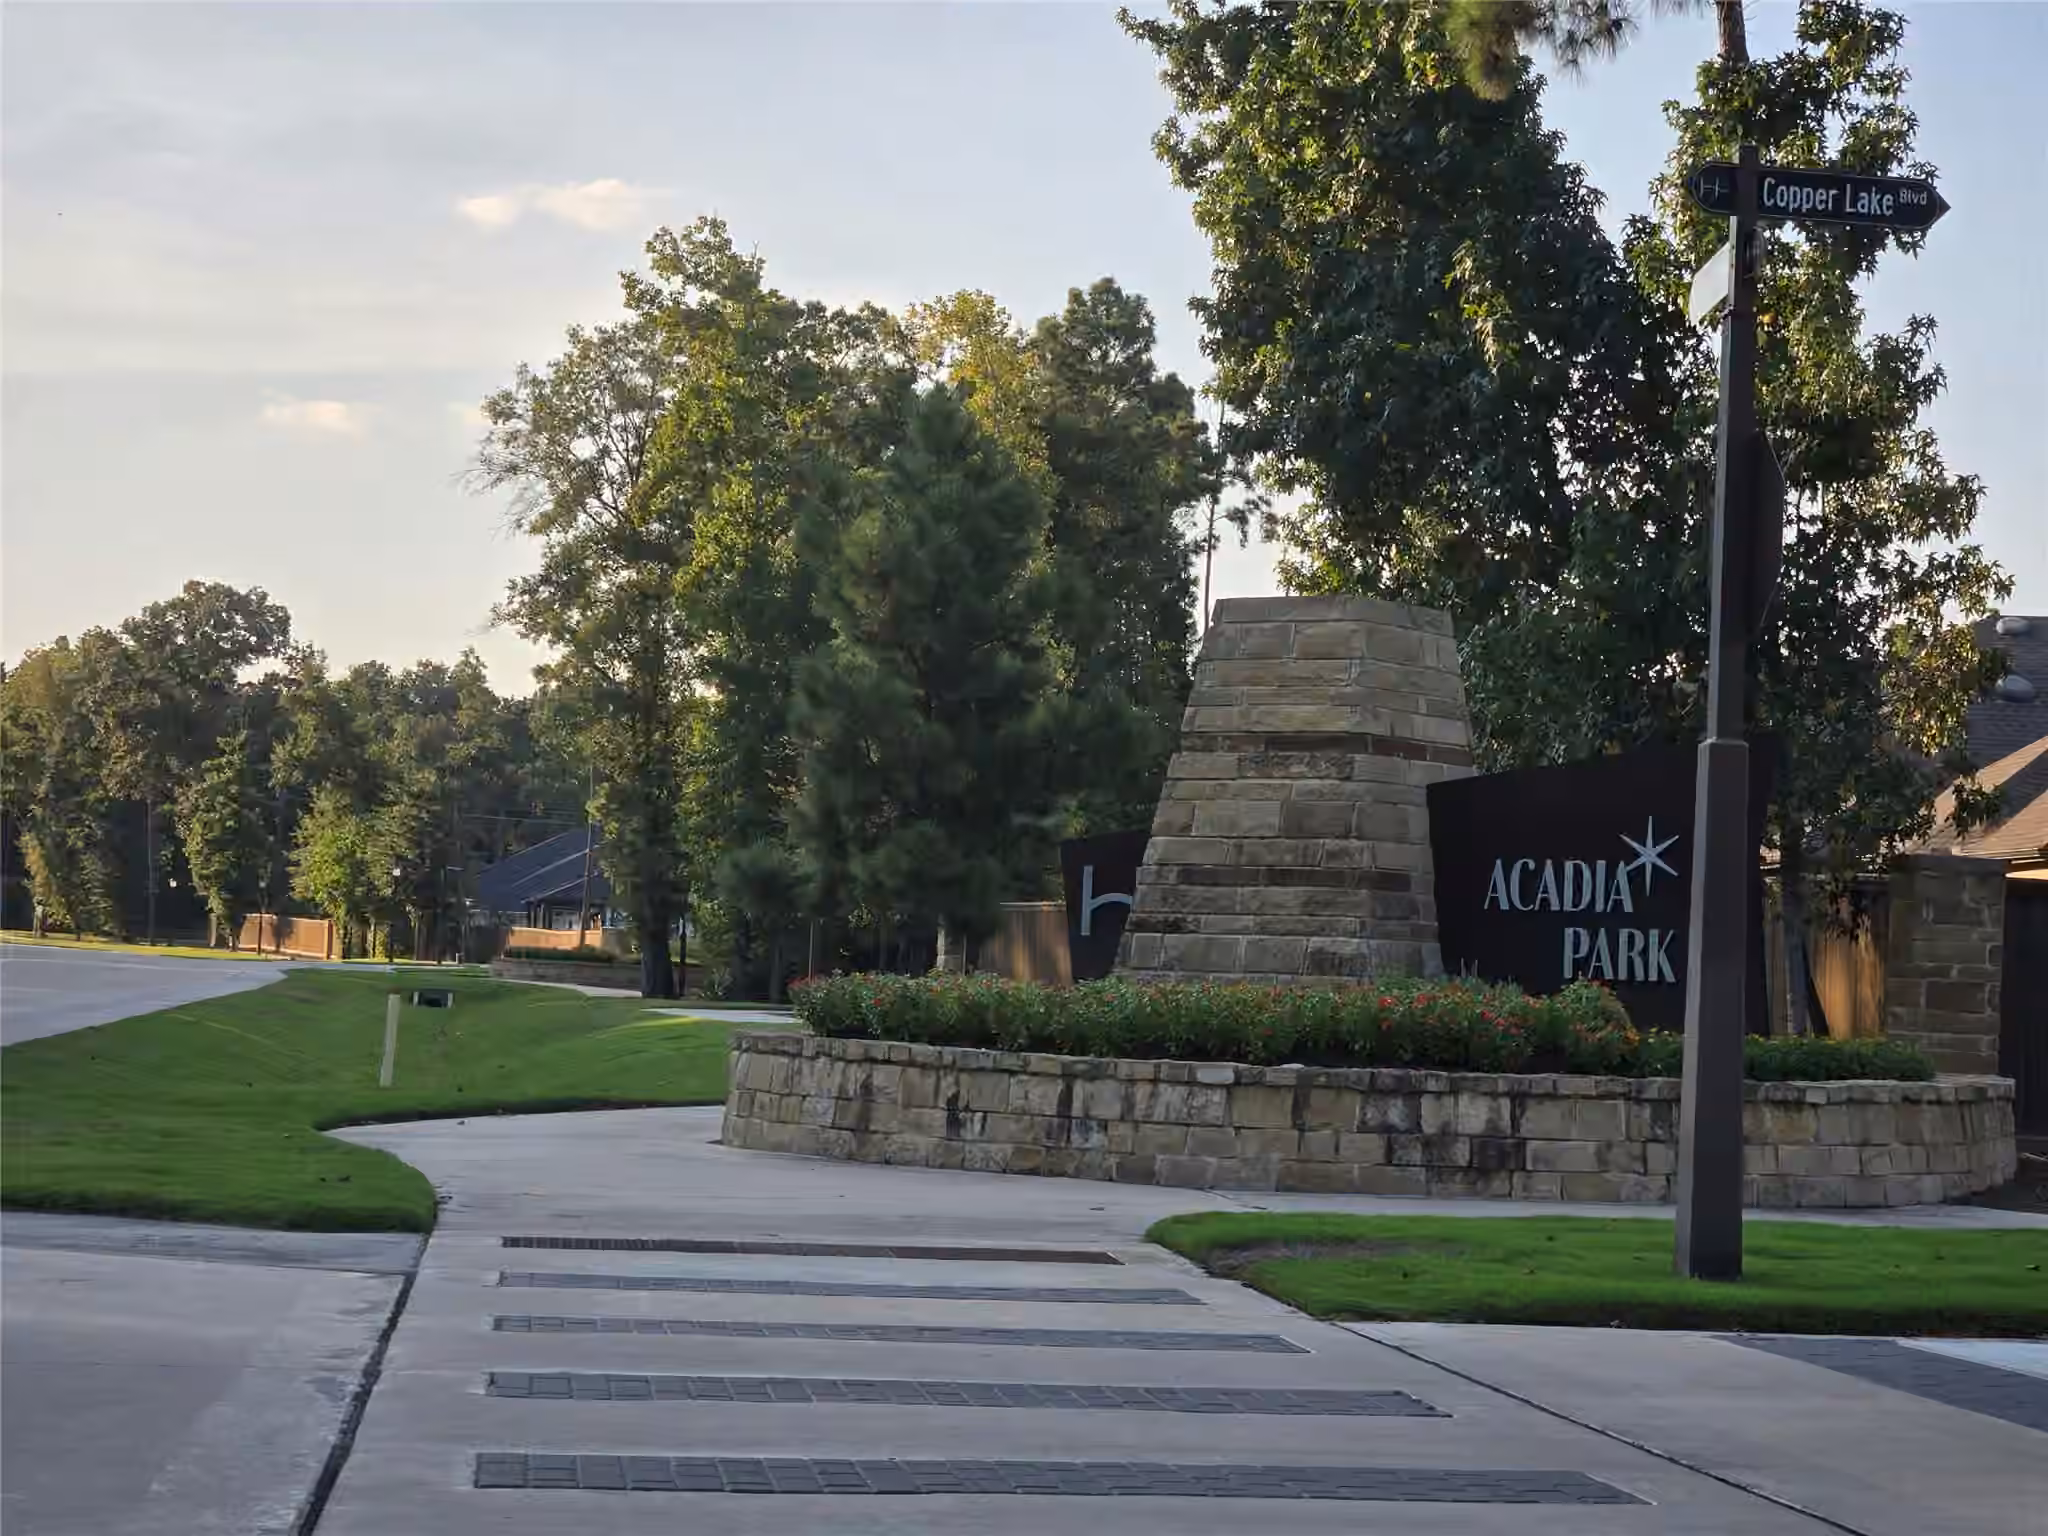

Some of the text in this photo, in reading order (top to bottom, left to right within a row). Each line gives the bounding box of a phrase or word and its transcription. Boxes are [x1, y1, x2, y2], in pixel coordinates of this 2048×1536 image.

[1763, 177, 1928, 216] Copper Lake Blvd
[1484, 858, 1634, 913] ACADIA
[1562, 926, 1676, 983] PARK
